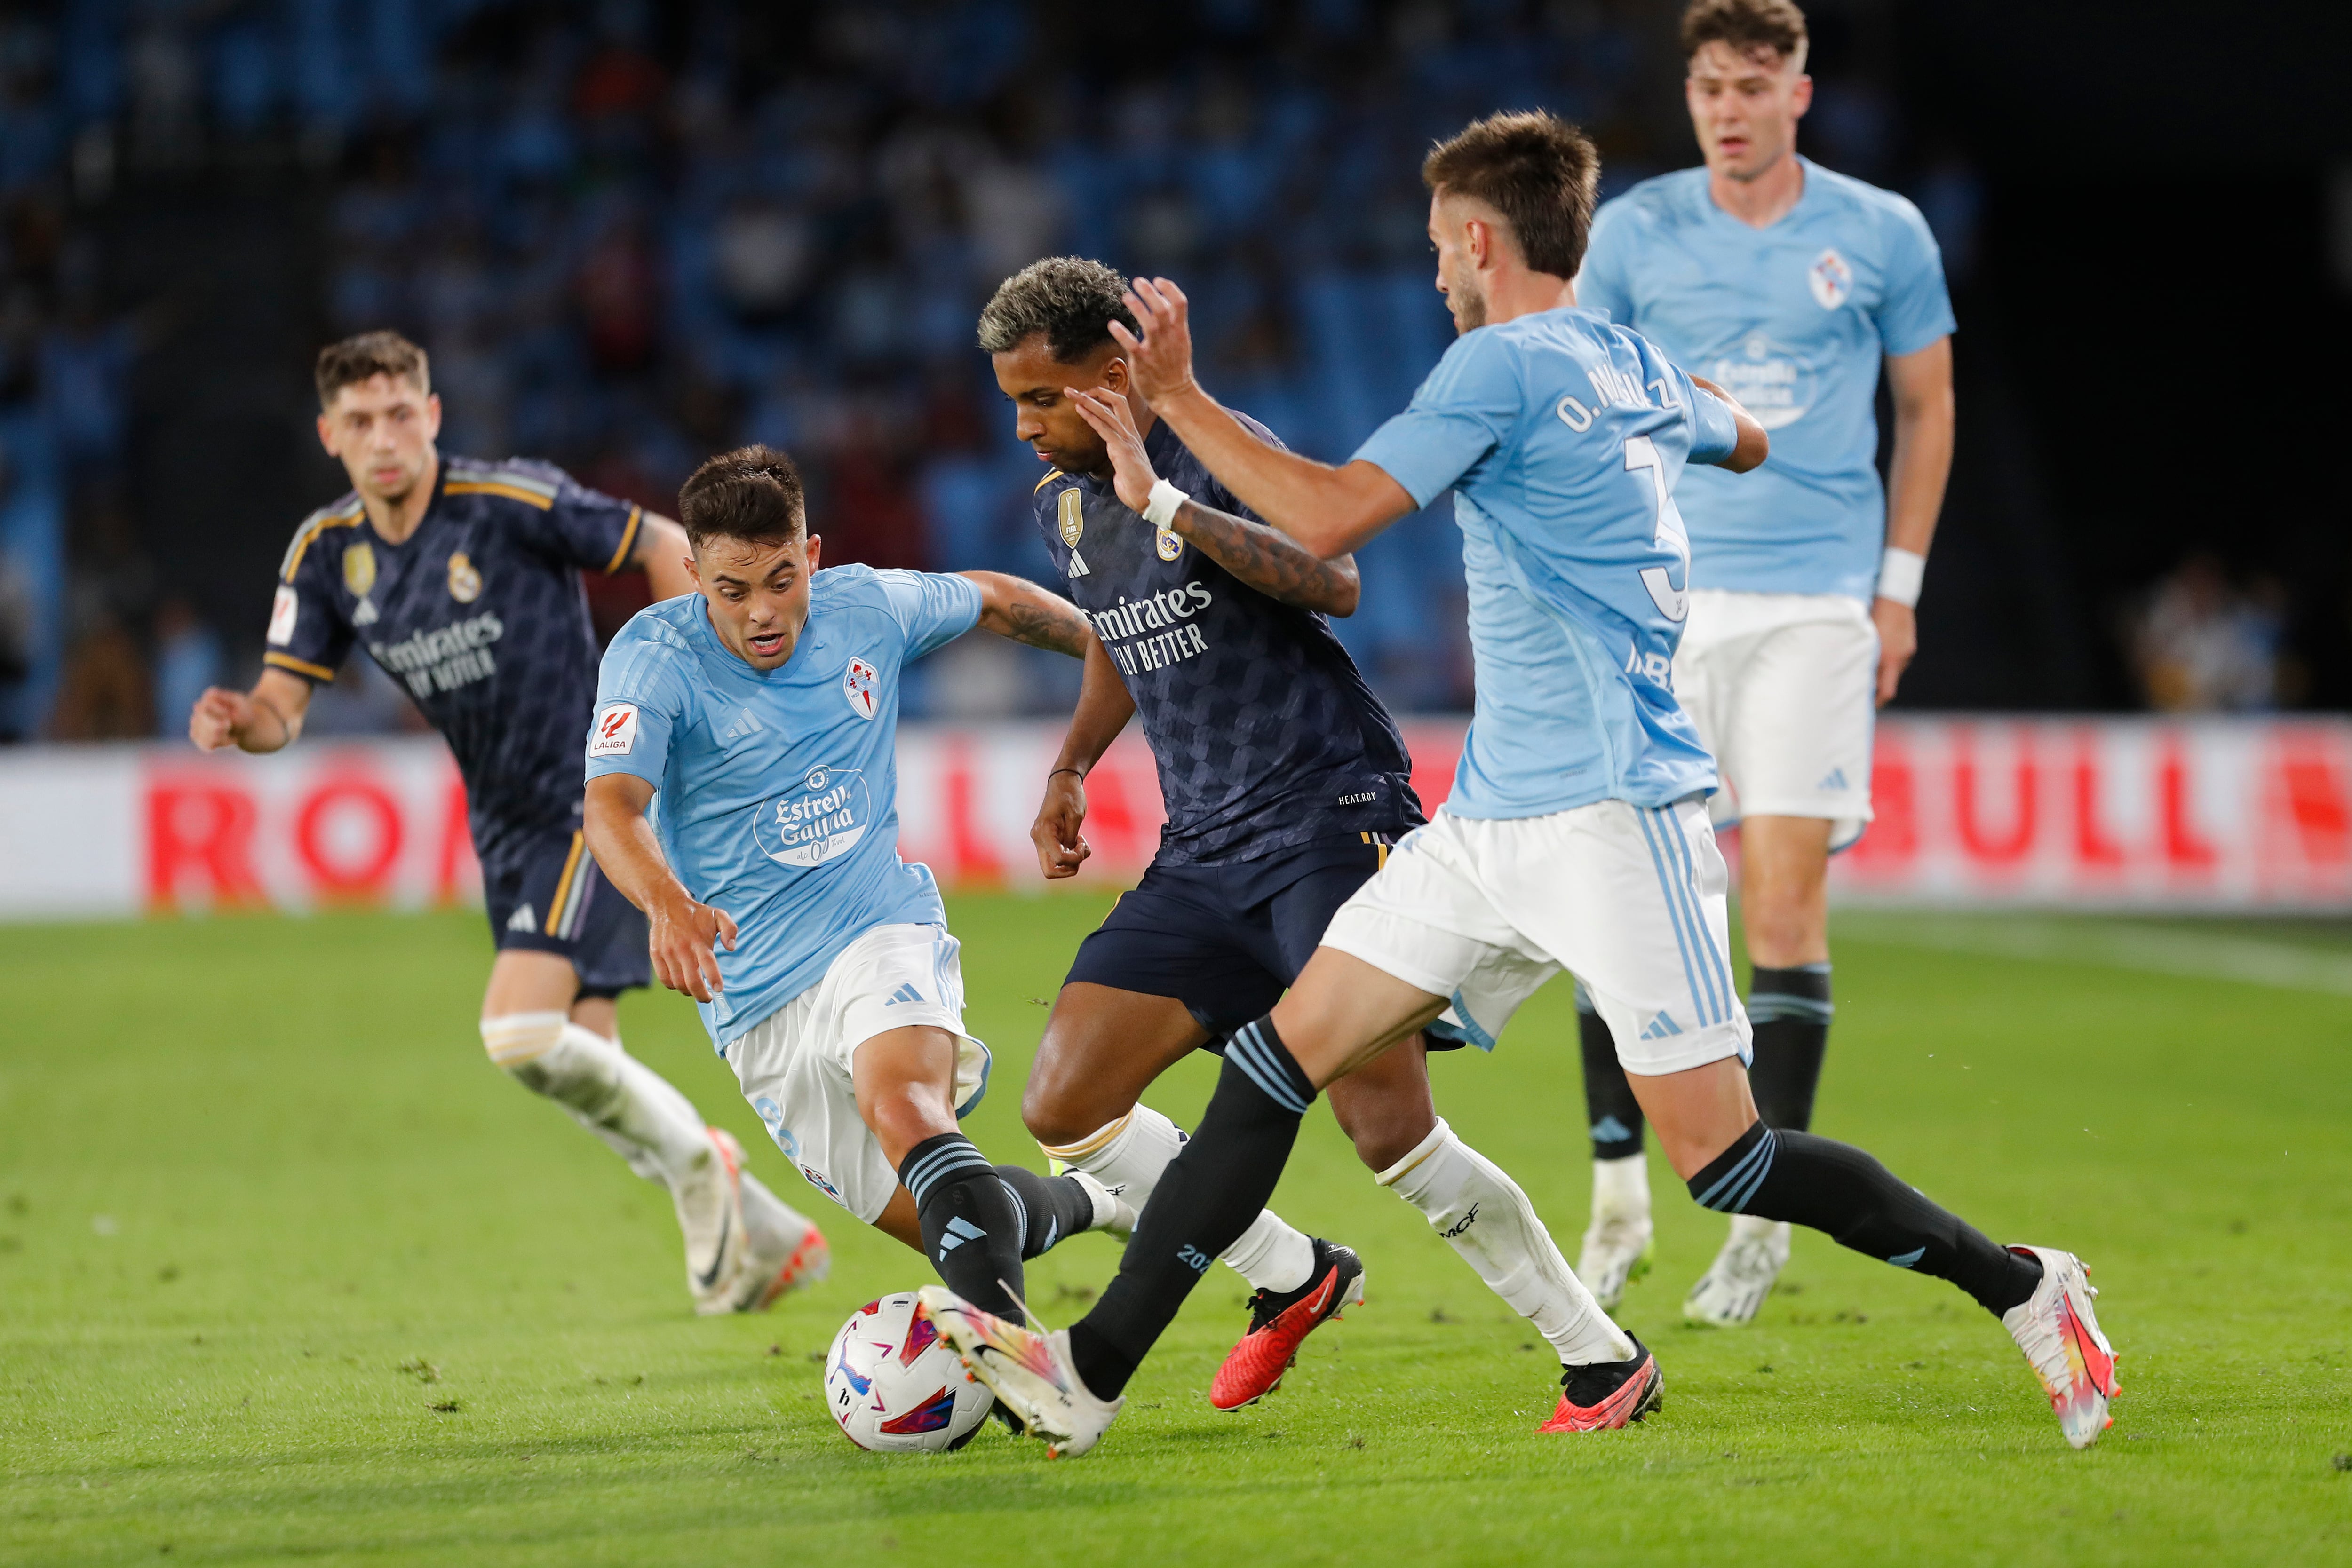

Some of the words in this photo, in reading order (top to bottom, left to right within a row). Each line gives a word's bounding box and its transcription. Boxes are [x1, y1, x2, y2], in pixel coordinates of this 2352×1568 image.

[1066, 525, 1078, 534] FIFA
[1623, 434, 1692, 622] 3
[1136, 623, 1209, 672] BETTER
[594, 741, 626, 750] LALIGA
[775, 785, 851, 824] Estrell
[1339, 792, 1376, 805] HEAT.RDY
[781, 808, 854, 845] Galiia
